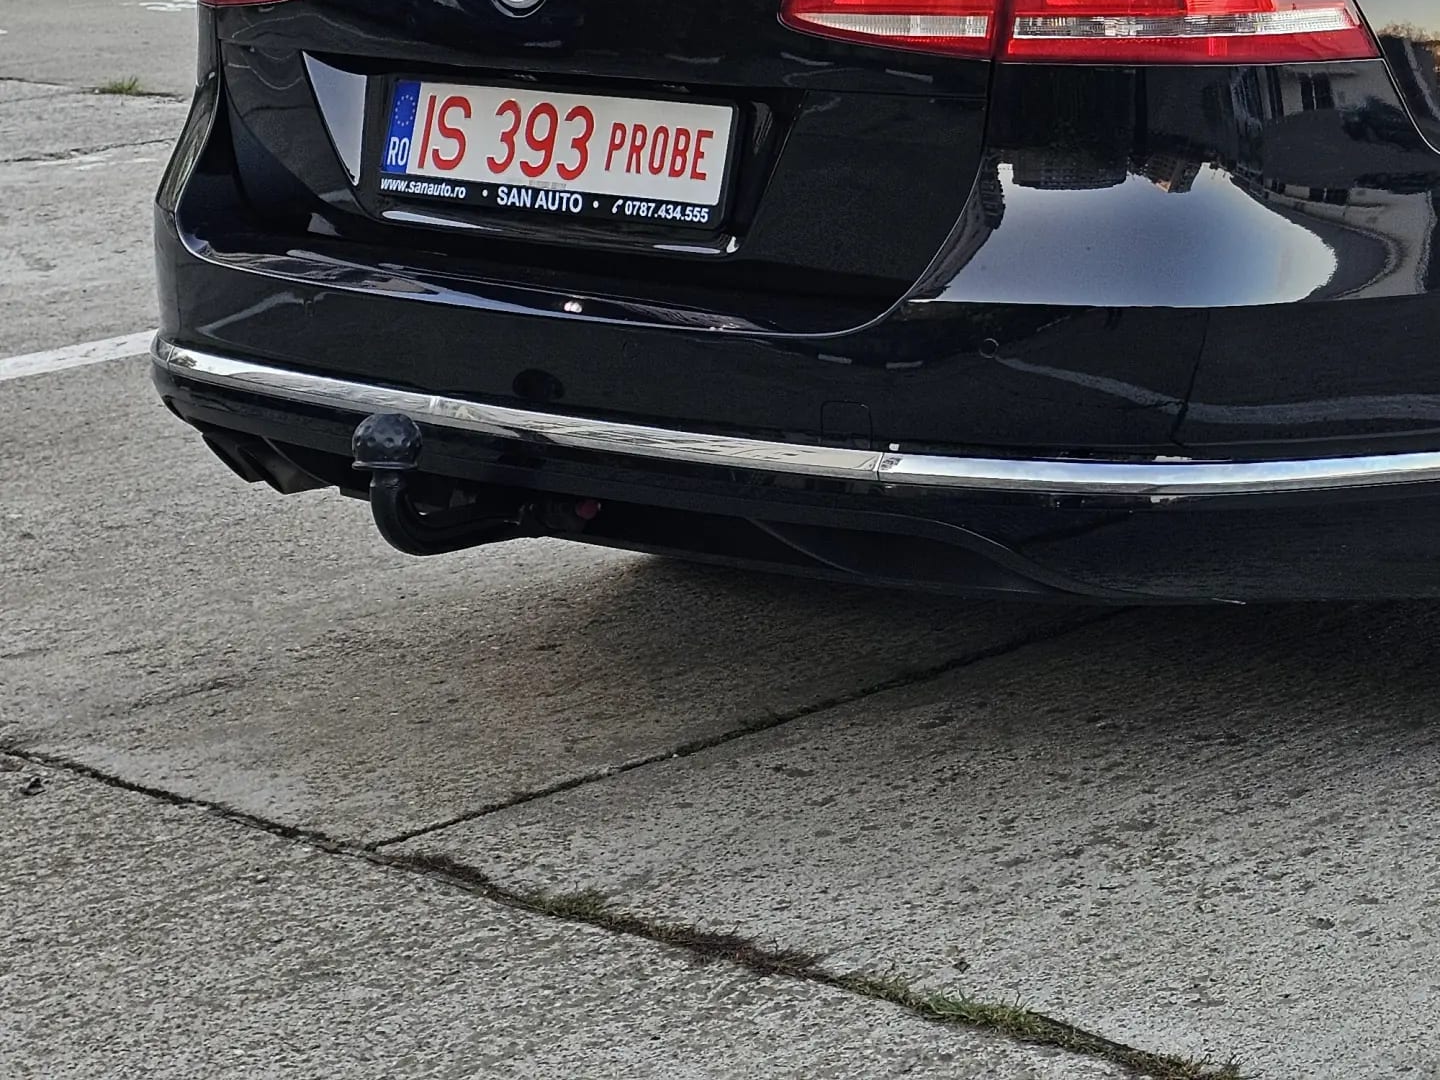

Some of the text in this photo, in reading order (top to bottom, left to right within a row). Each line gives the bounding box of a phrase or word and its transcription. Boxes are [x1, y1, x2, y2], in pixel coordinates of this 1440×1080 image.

[386, 136, 411, 166] RO
[417, 95, 714, 181] IS 393 PROBE
[380, 176, 710, 224] www.sanauto.ro SAN AUTO 0787.434.555
